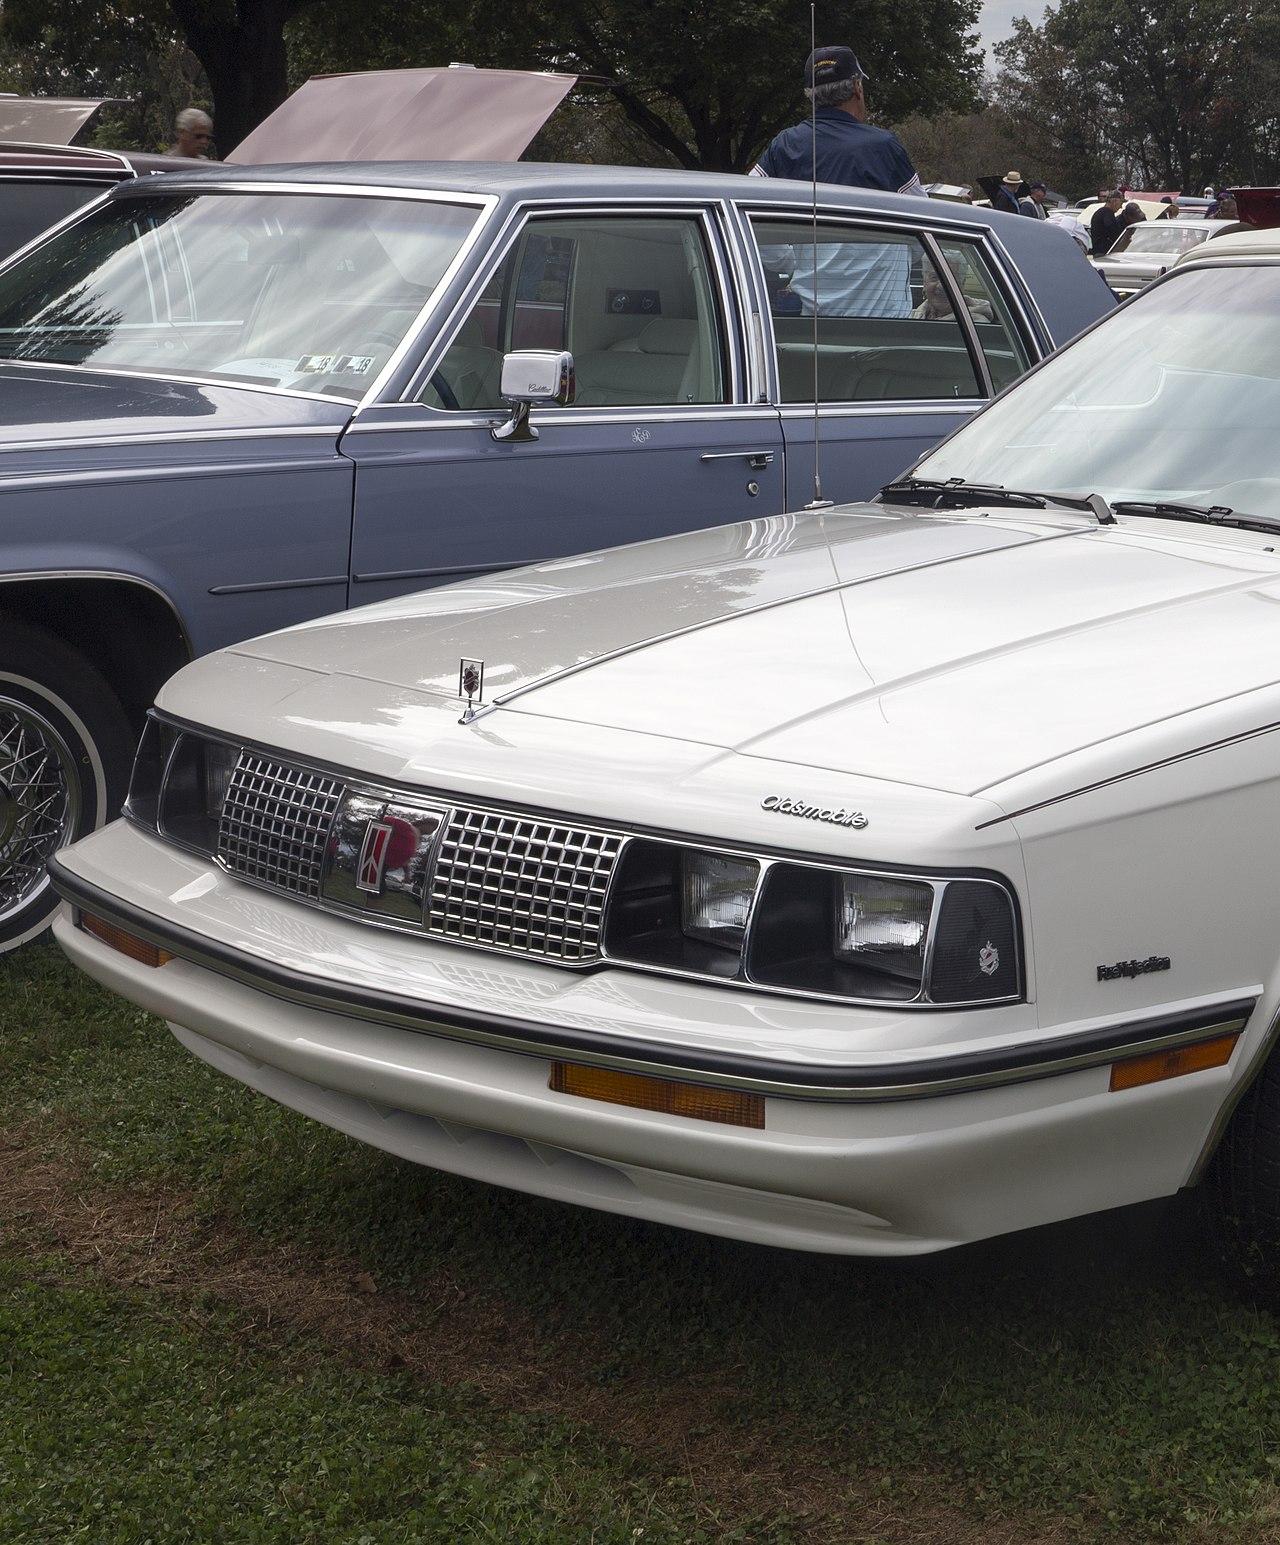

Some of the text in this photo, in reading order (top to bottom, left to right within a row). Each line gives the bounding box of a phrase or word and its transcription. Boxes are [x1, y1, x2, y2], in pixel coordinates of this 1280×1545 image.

[318, 357, 331, 371] 18
[356, 358, 371, 372] 18
[760, 794, 869, 830] Oldsmobile
